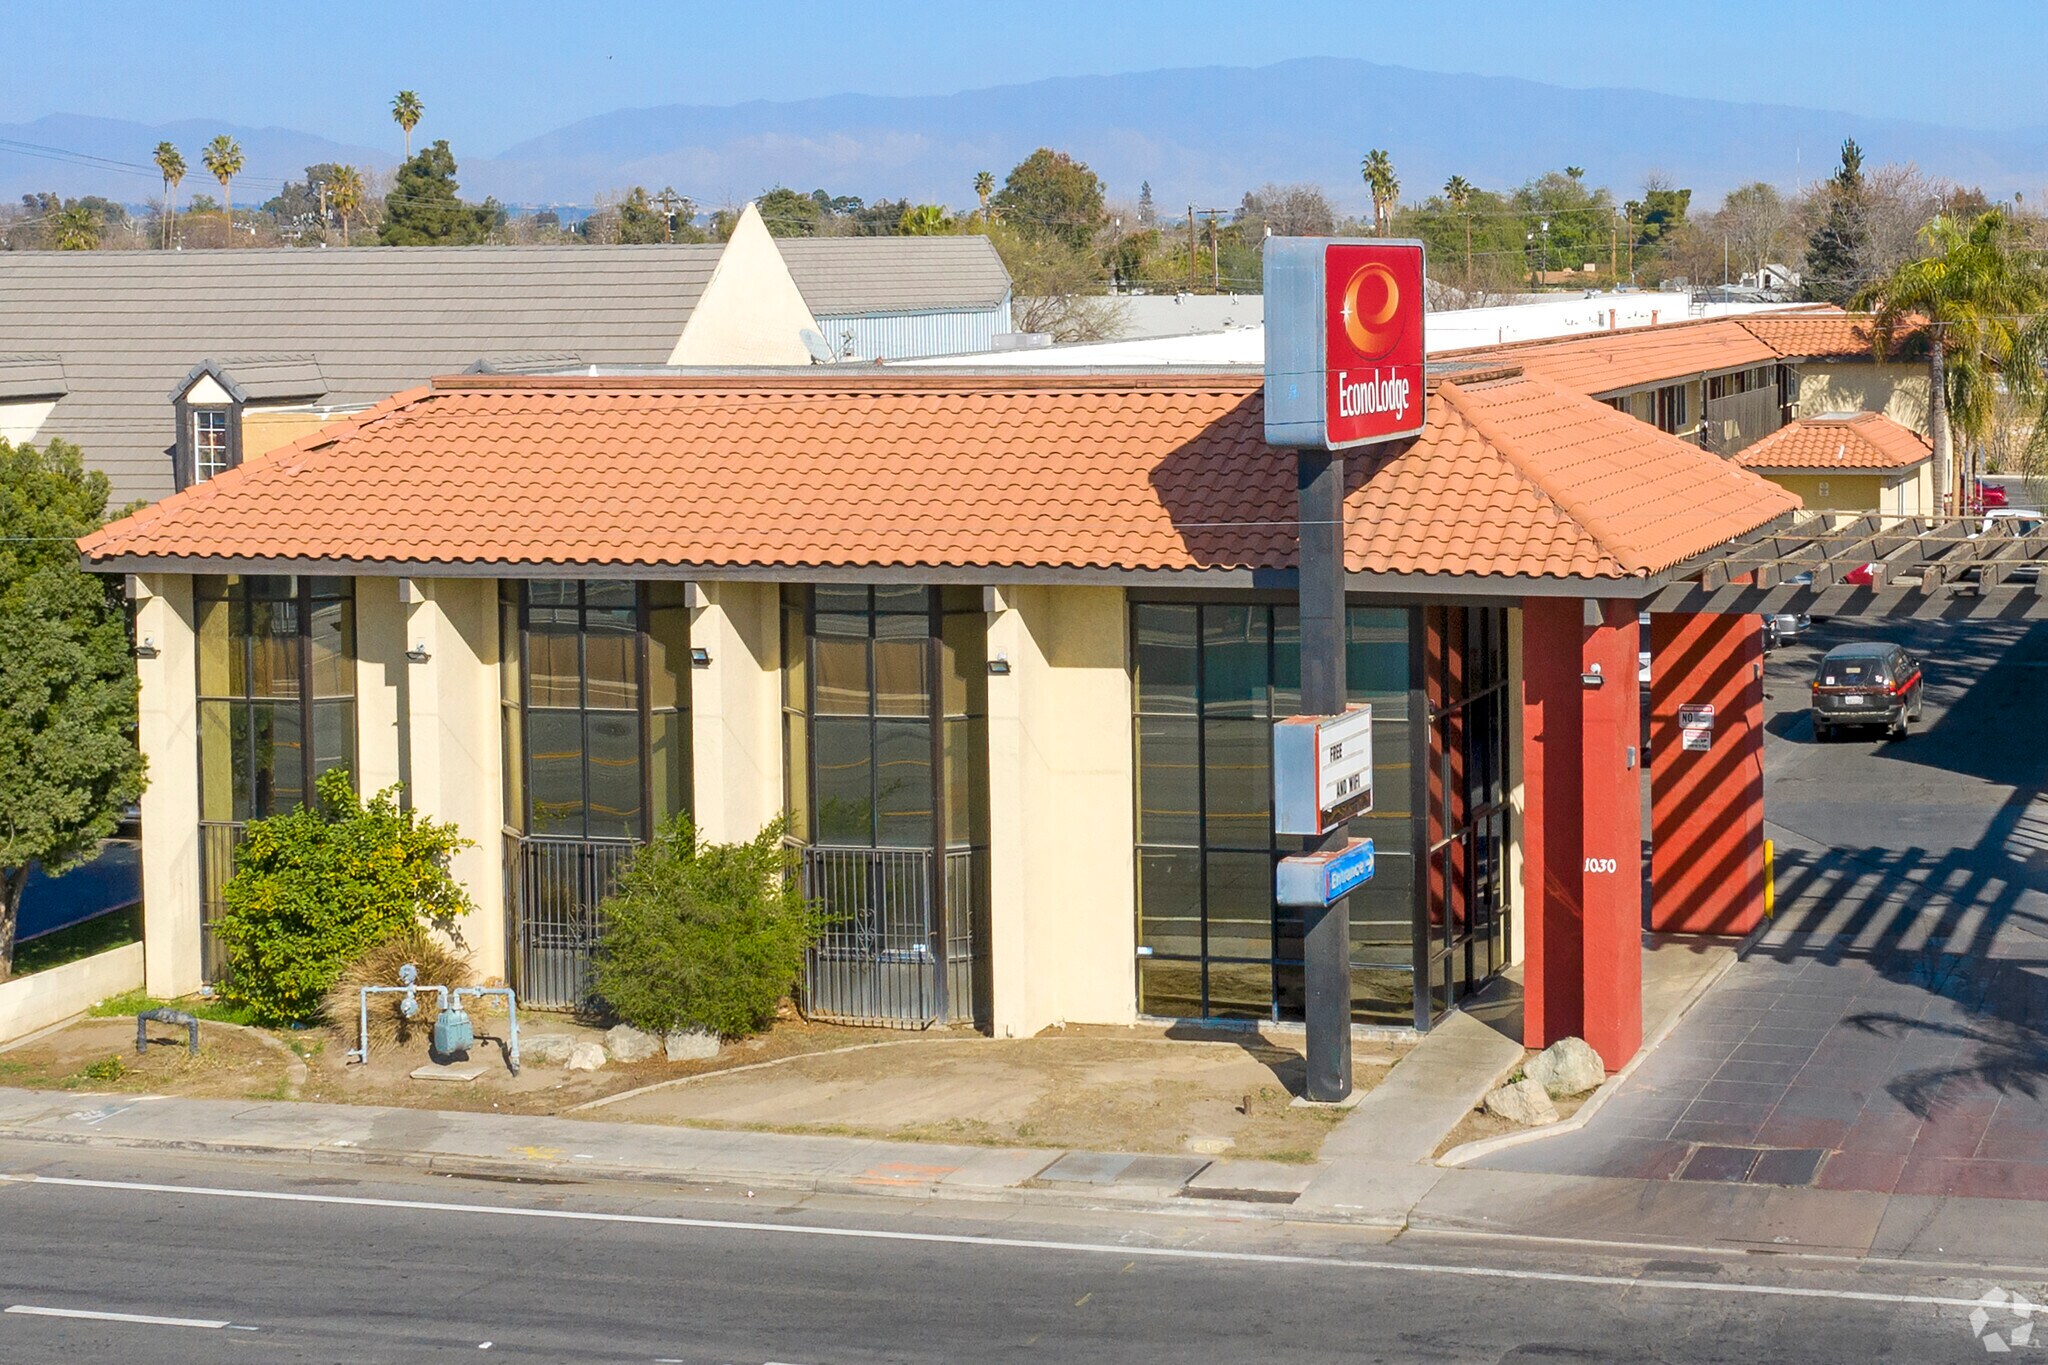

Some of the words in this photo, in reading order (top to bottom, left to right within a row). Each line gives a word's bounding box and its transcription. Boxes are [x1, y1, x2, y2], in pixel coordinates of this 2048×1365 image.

[1339, 367, 1409, 420] EconoLodge
[1682, 712, 1693, 723] NO
[1330, 742, 1342, 763] FREE
[1337, 777, 1347, 798] AND
[1332, 862, 1364, 889] Entrance
[1583, 857, 1617, 874] 1030
